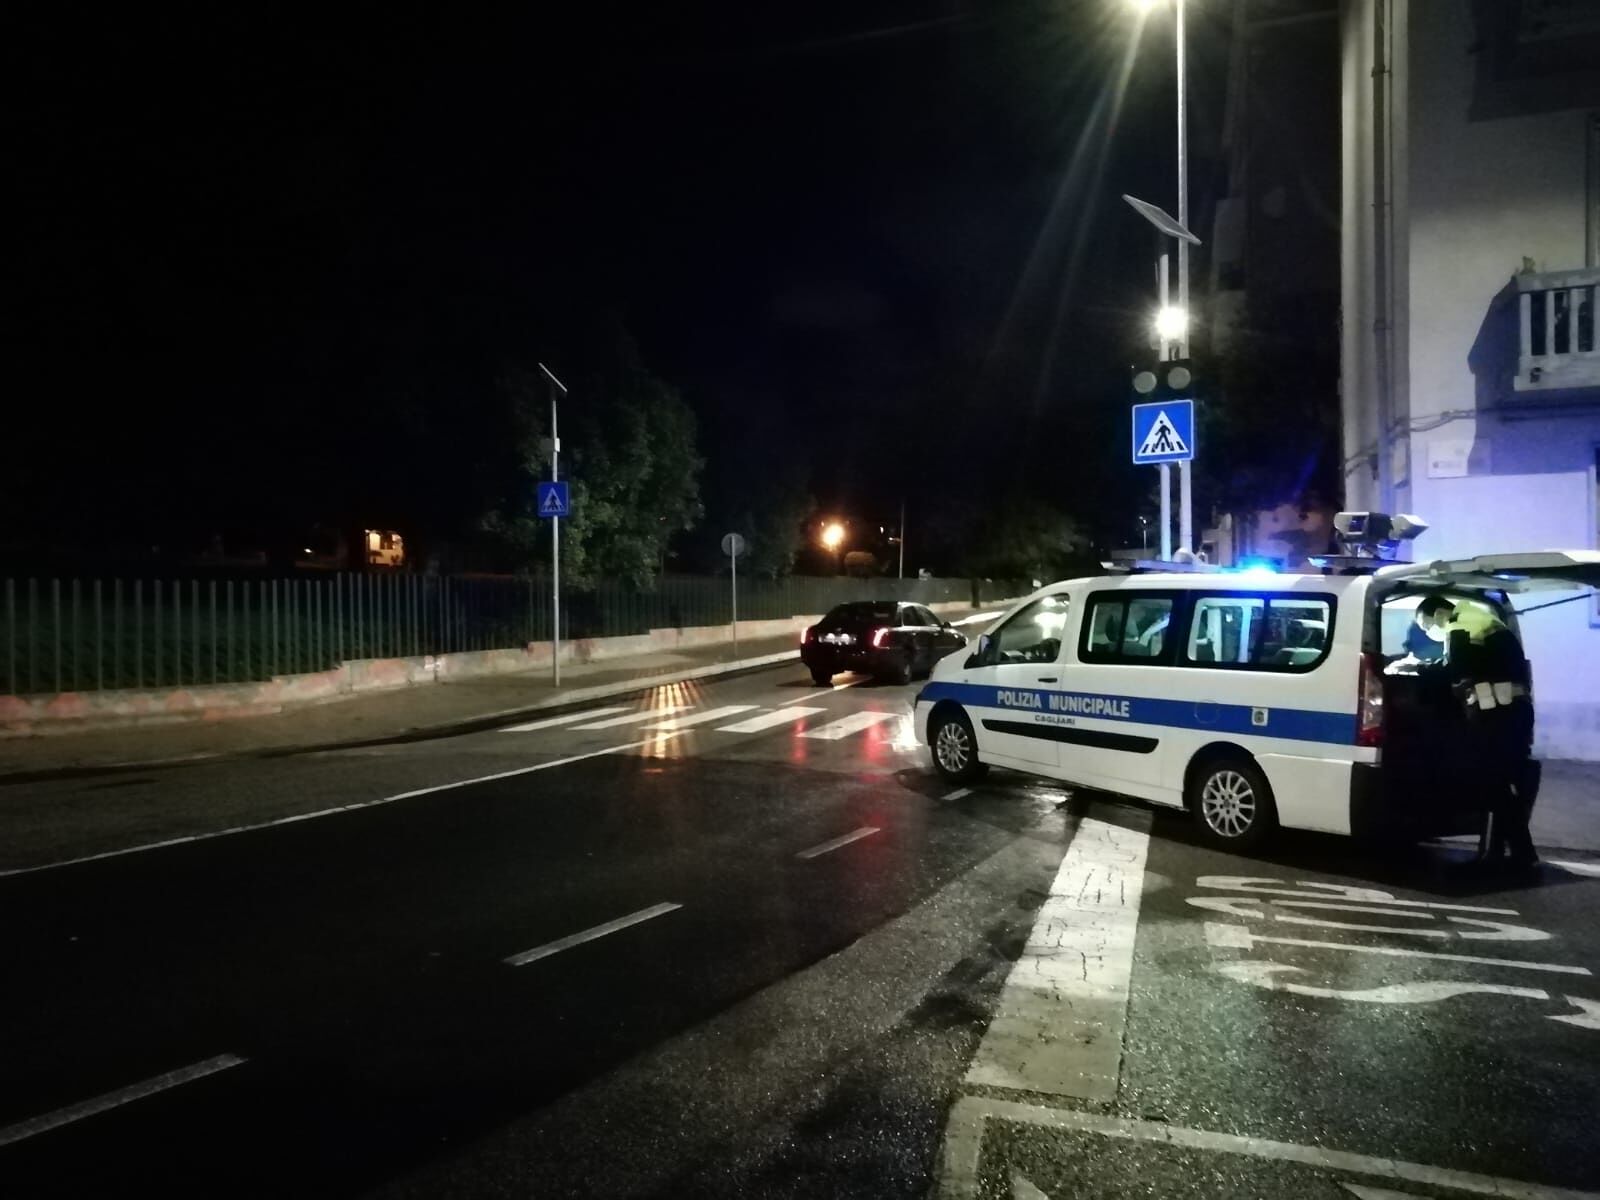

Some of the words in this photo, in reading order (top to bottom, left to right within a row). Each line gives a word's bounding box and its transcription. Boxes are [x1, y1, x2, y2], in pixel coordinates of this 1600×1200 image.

[996, 690, 1042, 708] POLIZIA
[1049, 694, 1130, 718] MUNICIPALE
[1034, 714, 1076, 726] CAGLIARI
